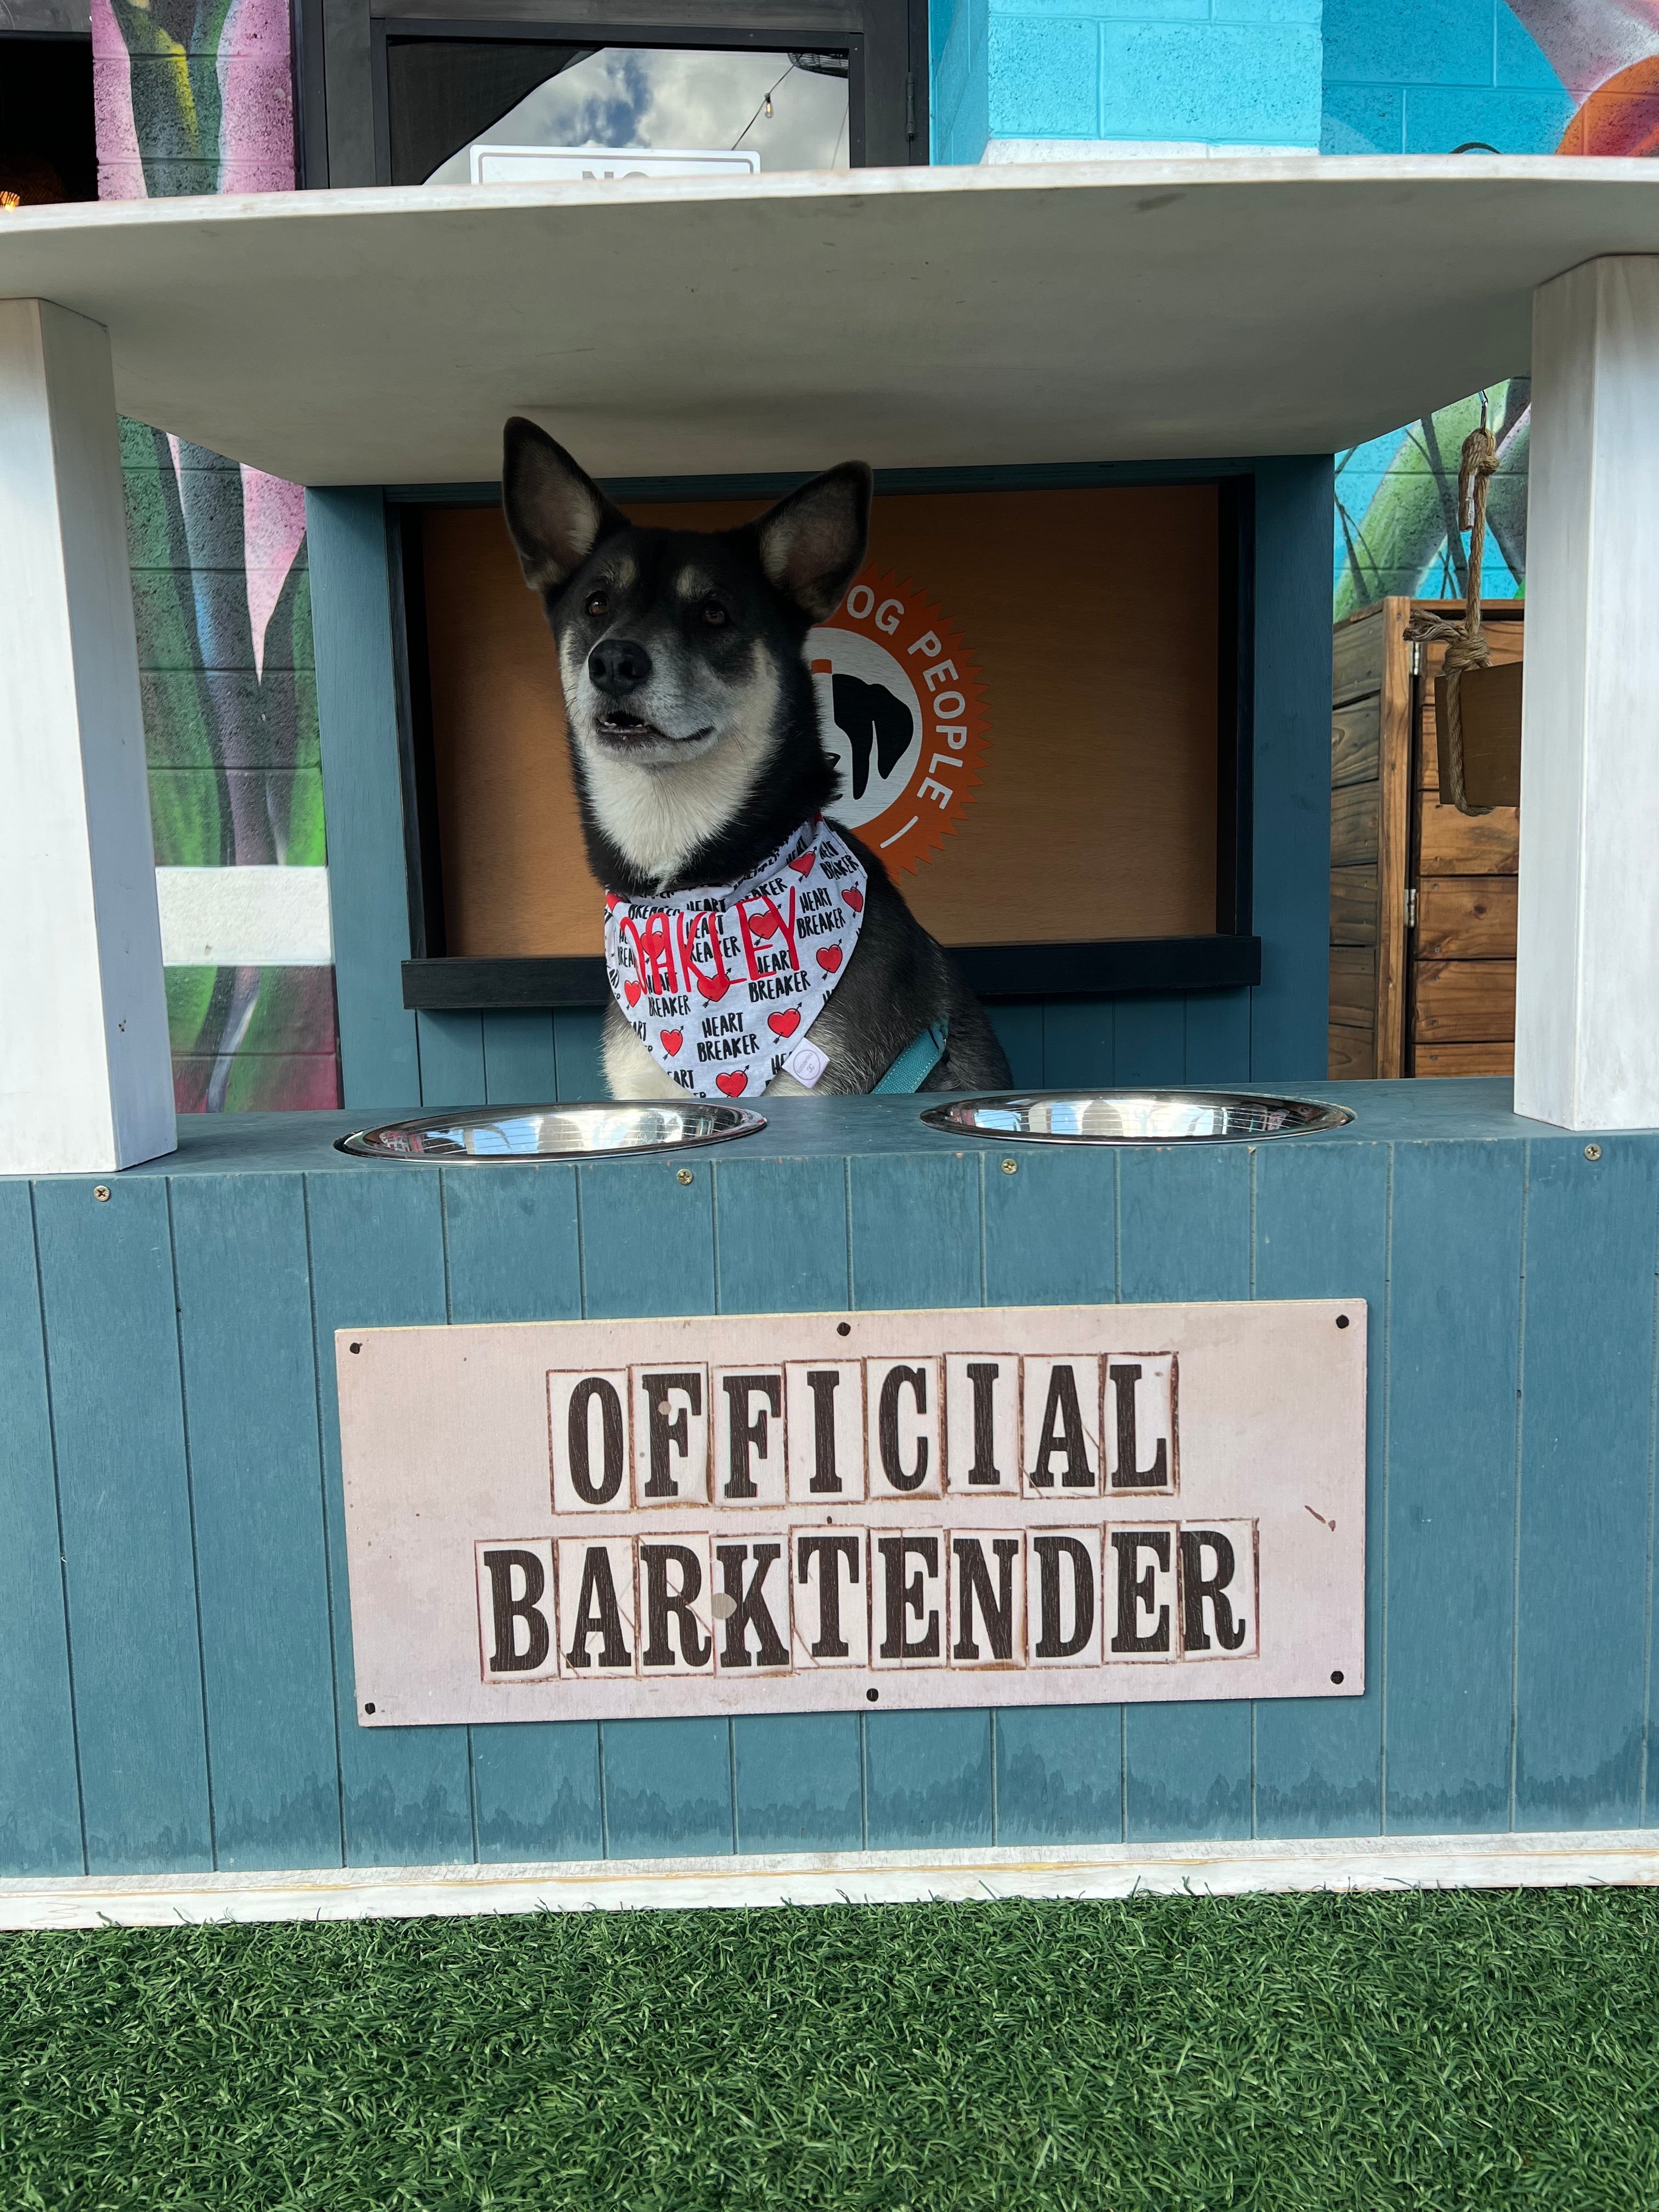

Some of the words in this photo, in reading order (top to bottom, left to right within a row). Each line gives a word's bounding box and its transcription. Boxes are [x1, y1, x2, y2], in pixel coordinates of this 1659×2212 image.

[847, 584, 905, 636] OG
[907, 630, 967, 810] PEOPLE
[628, 904, 681, 921] BREAER
[799, 887, 832, 913] HEART
[686, 914, 724, 939] HEAT
[796, 907, 846, 939] BREAKER
[757, 950, 793, 974] HEAR
[748, 970, 811, 1003] BREAKER
[648, 995, 691, 1018] BREAKER
[702, 1012, 744, 1037] HEART
[697, 1034, 760, 1063] BREAKER
[567, 1363, 1168, 1505] OFFICIAL
[482, 1530, 1246, 1672] BARKTENDER
